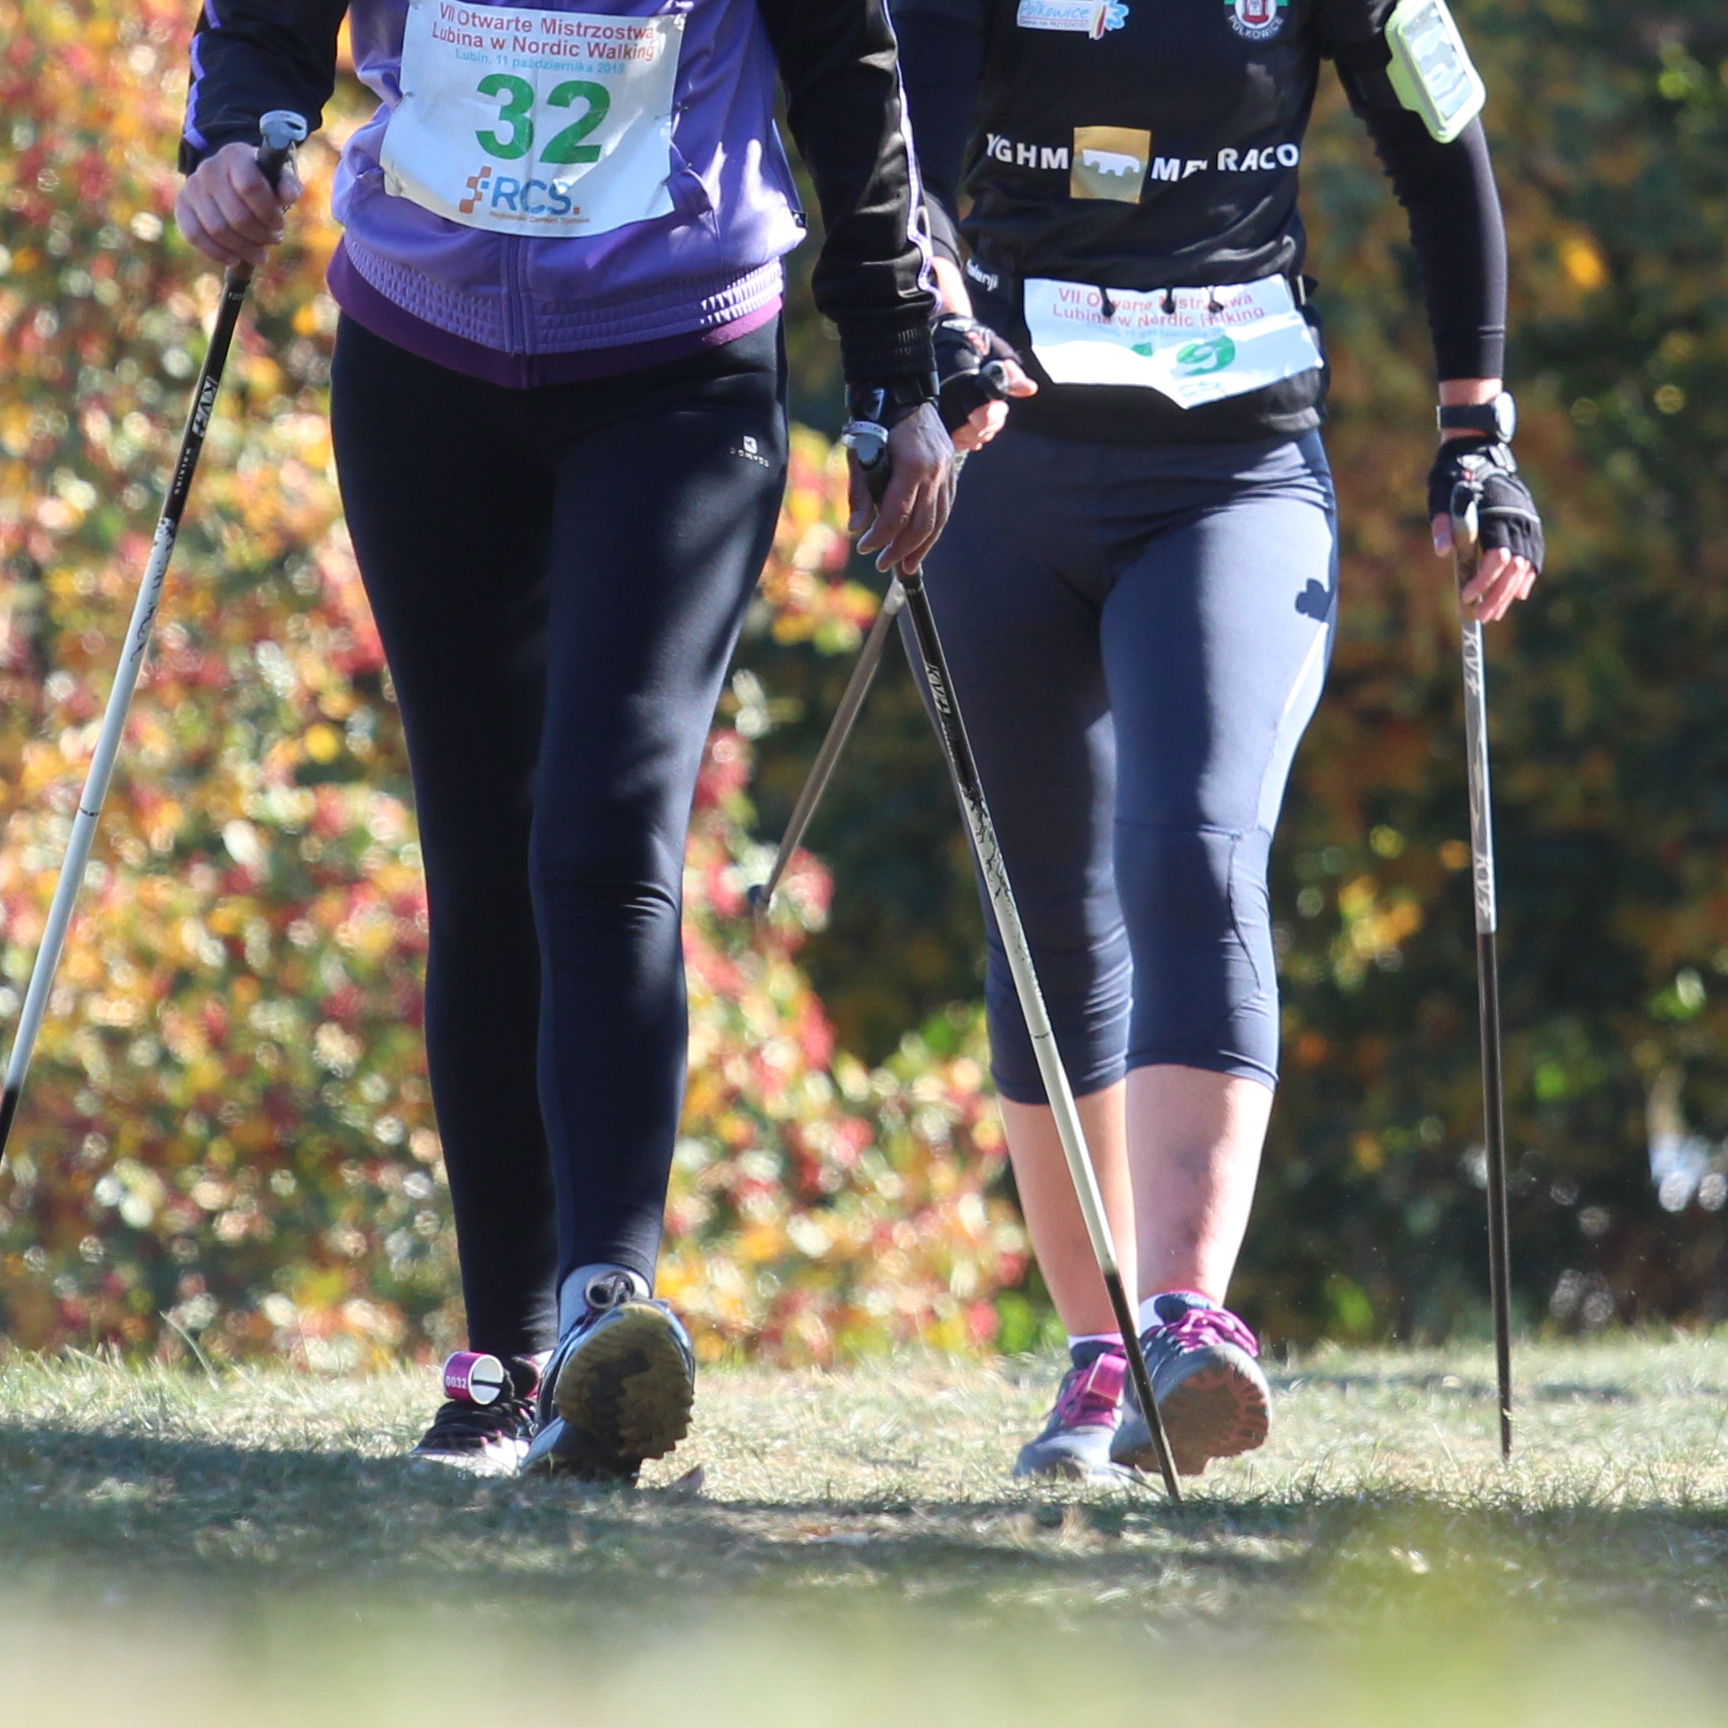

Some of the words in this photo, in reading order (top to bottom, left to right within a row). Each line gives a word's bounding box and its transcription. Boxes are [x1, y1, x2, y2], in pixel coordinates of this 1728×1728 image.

[440, 3, 455, 22] VII
[457, 9, 533, 33] Otwarte
[540, 17, 655, 40] Mistrzostwa
[432, 21, 484, 48] Lubina
[490, 37, 507, 50] w
[512, 35, 580, 57] Nordic
[587, 41, 655, 62] Walking
[496, 54, 508, 65] 11
[475, 73, 611, 164] 32
[1058, 287, 1081, 305] VII
[1117, 315, 1132, 328] w
[445, 1375, 468, 1390] 0032
